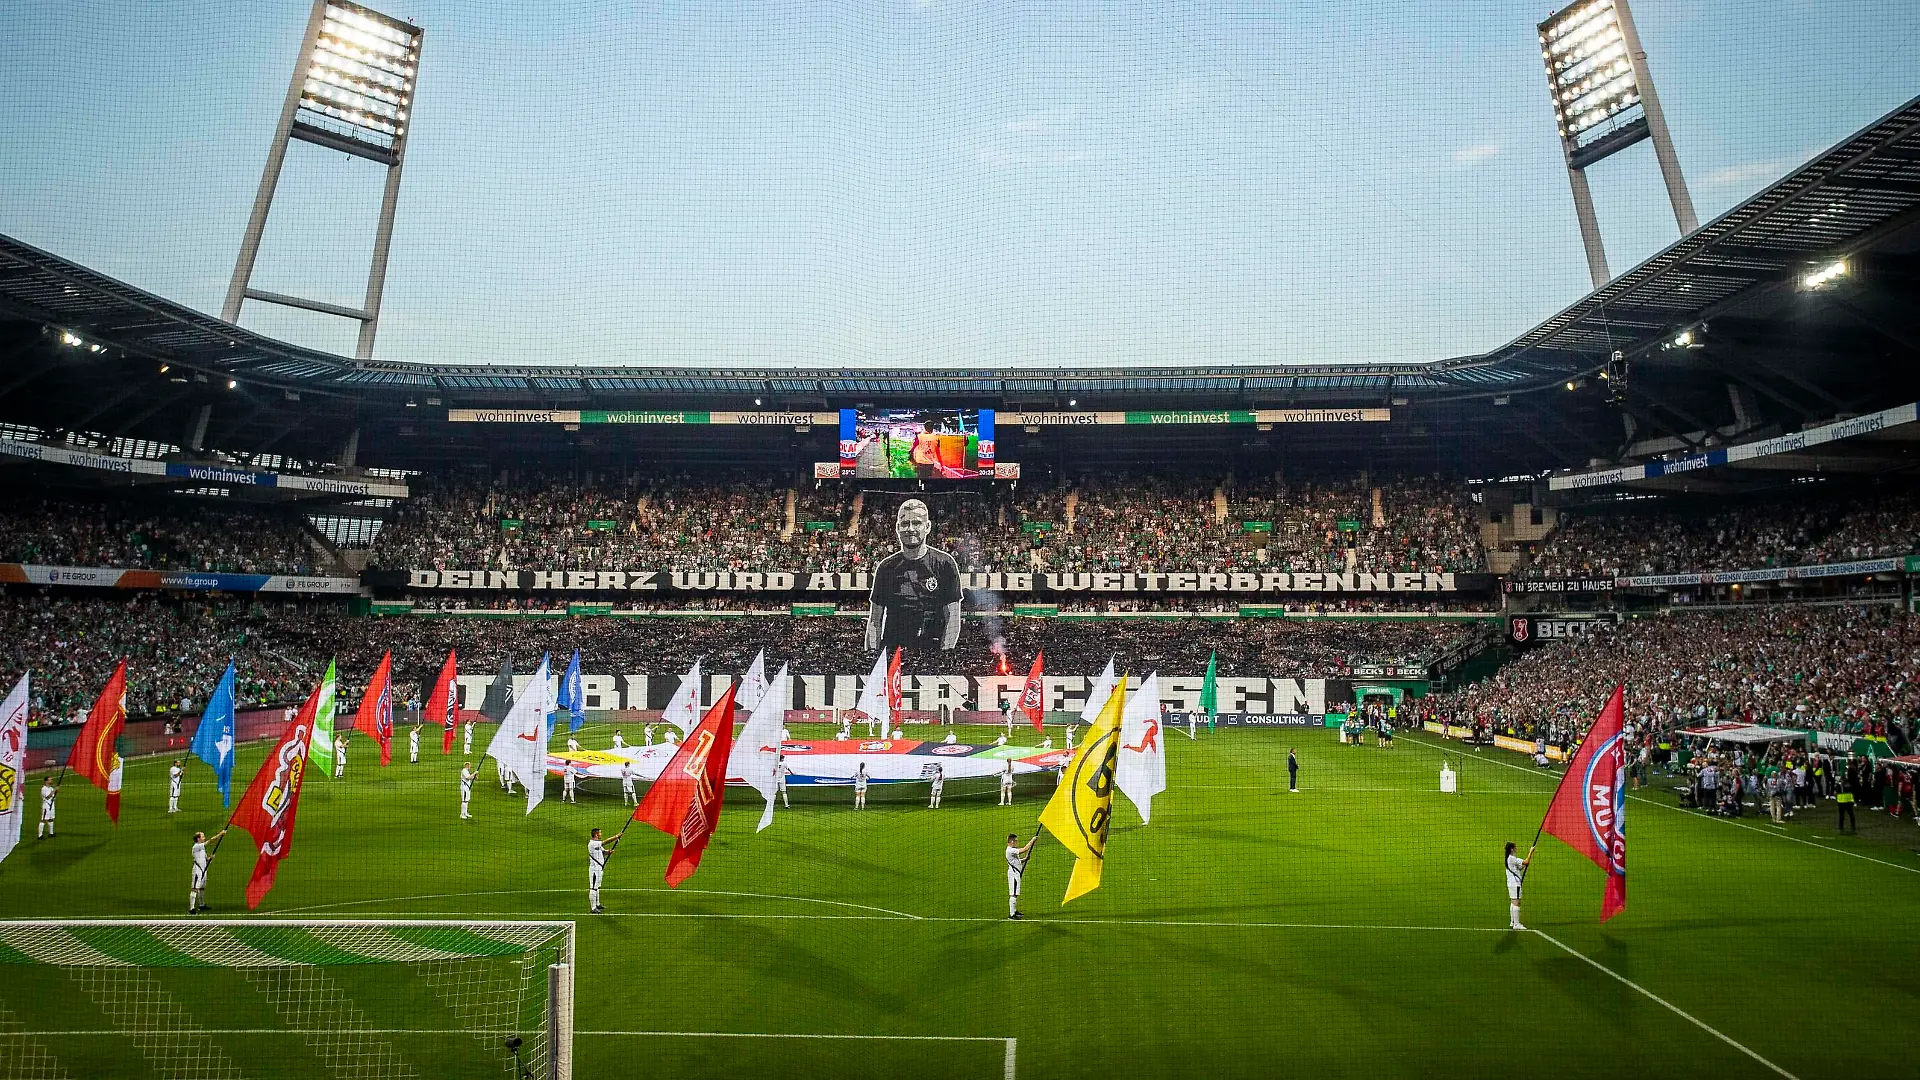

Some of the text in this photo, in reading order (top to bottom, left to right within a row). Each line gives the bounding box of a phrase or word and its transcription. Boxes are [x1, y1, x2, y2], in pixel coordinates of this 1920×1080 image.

[476, 411, 554, 423] wohninvest
[607, 412, 684, 424] wohninvest
[738, 412, 814, 425] wohninvest
[1021, 412, 1098, 425] wohninvest
[1152, 411, 1229, 424] wohninvest
[1284, 410, 1363, 422] wohninvest
[1831, 416, 1884, 440] wohninvest
[1756, 435, 1806, 457] wohninvest
[68, 454, 133, 472] wohninvest
[1663, 455, 1708, 474] wohninvest
[190, 468, 256, 485] wohninvest
[1572, 470, 1623, 488] wohninvest
[306, 480, 369, 495] wohninvest
[62, 572, 71, 580] FE
[161, 576, 219, 586] www.fe.group
[407, 570, 520, 589] DEIN
[533, 570, 658, 590] HERZ
[670, 571, 795, 591] WIRD
[806, 572, 873, 591] AU
[1046, 572, 1458, 592] WEITERBRENNEN
[1632, 577, 1651, 585] VOLLE
[1678, 575, 1699, 583] BREMEN
[1715, 573, 1742, 582] OFFENSIV
[1515, 581, 1525, 592] IN
[1527, 580, 1564, 592] BREMEN
[1567, 580, 1579, 591] ZU
[1582, 580, 1613, 591] HAUSE
[1194, 715, 1220, 724] UDT
[1245, 715, 1306, 725] CONSULTING
